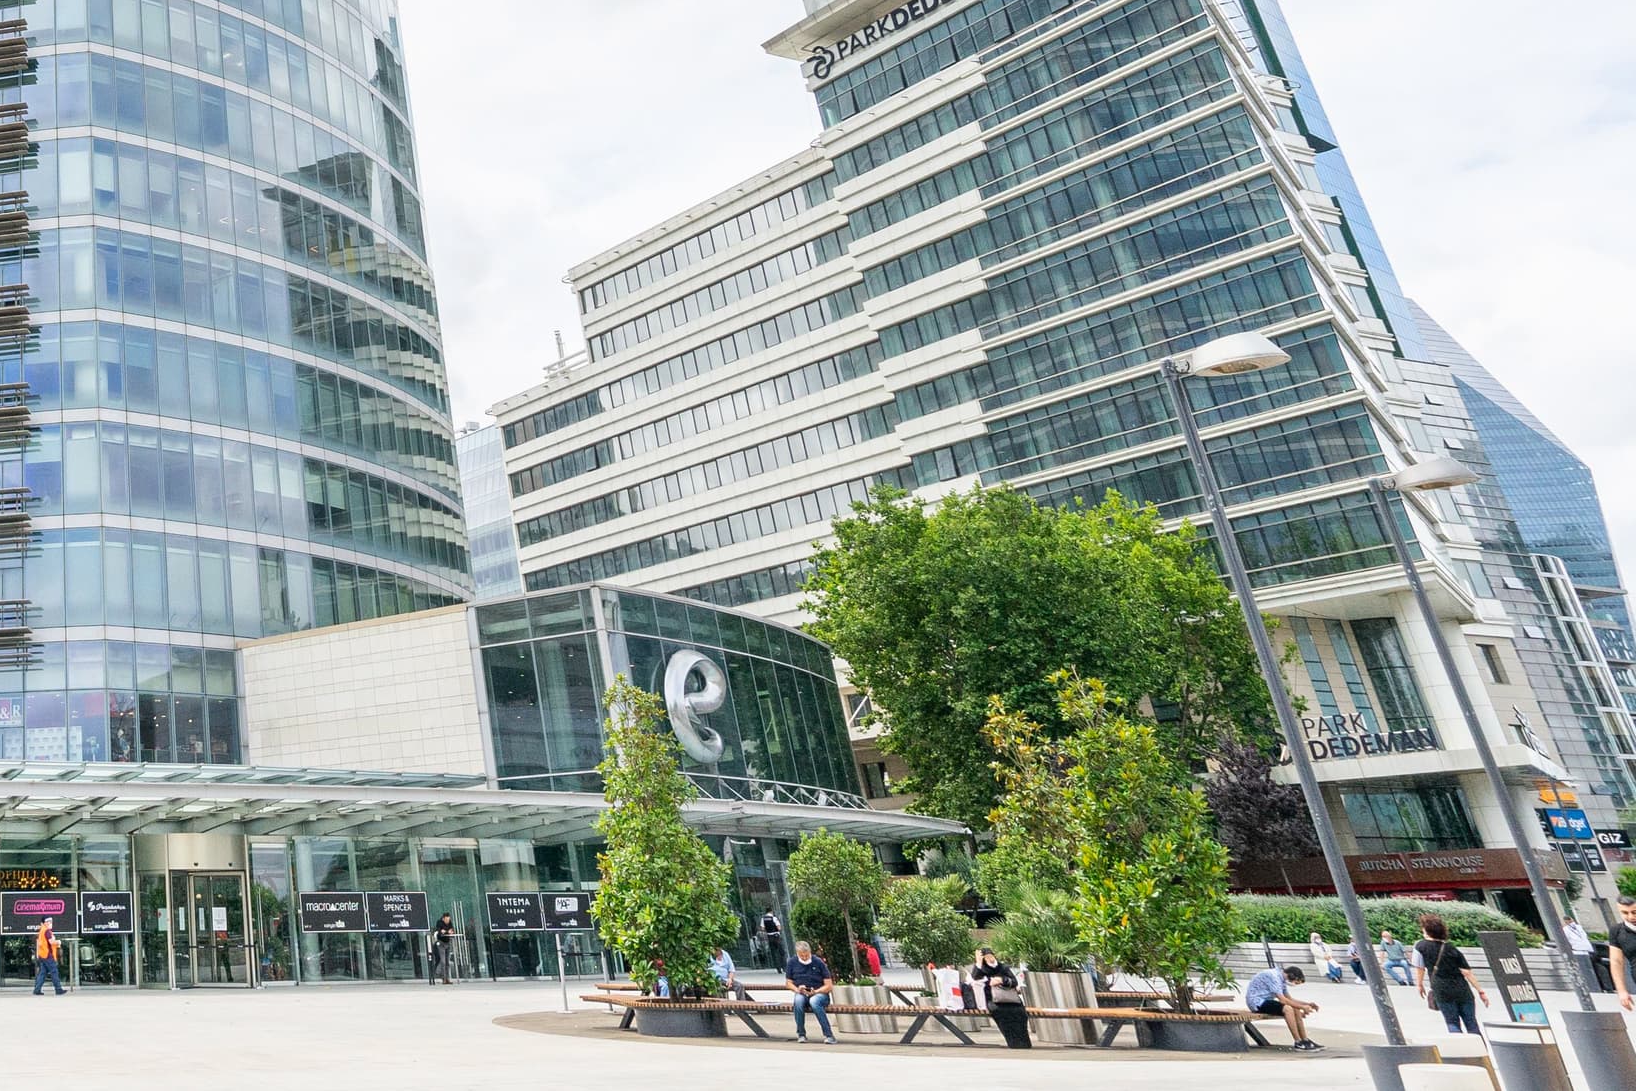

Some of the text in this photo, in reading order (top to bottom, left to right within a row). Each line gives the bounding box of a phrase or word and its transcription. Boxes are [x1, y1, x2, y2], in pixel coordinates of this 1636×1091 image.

[1301, 712, 1368, 738] PARK
[1308, 727, 1439, 760] DEDEMAN
[1411, 855, 1484, 869] STEAKHOUSE
[383, 894, 405, 902] MARKS
[383, 903, 413, 912] SPENCER
